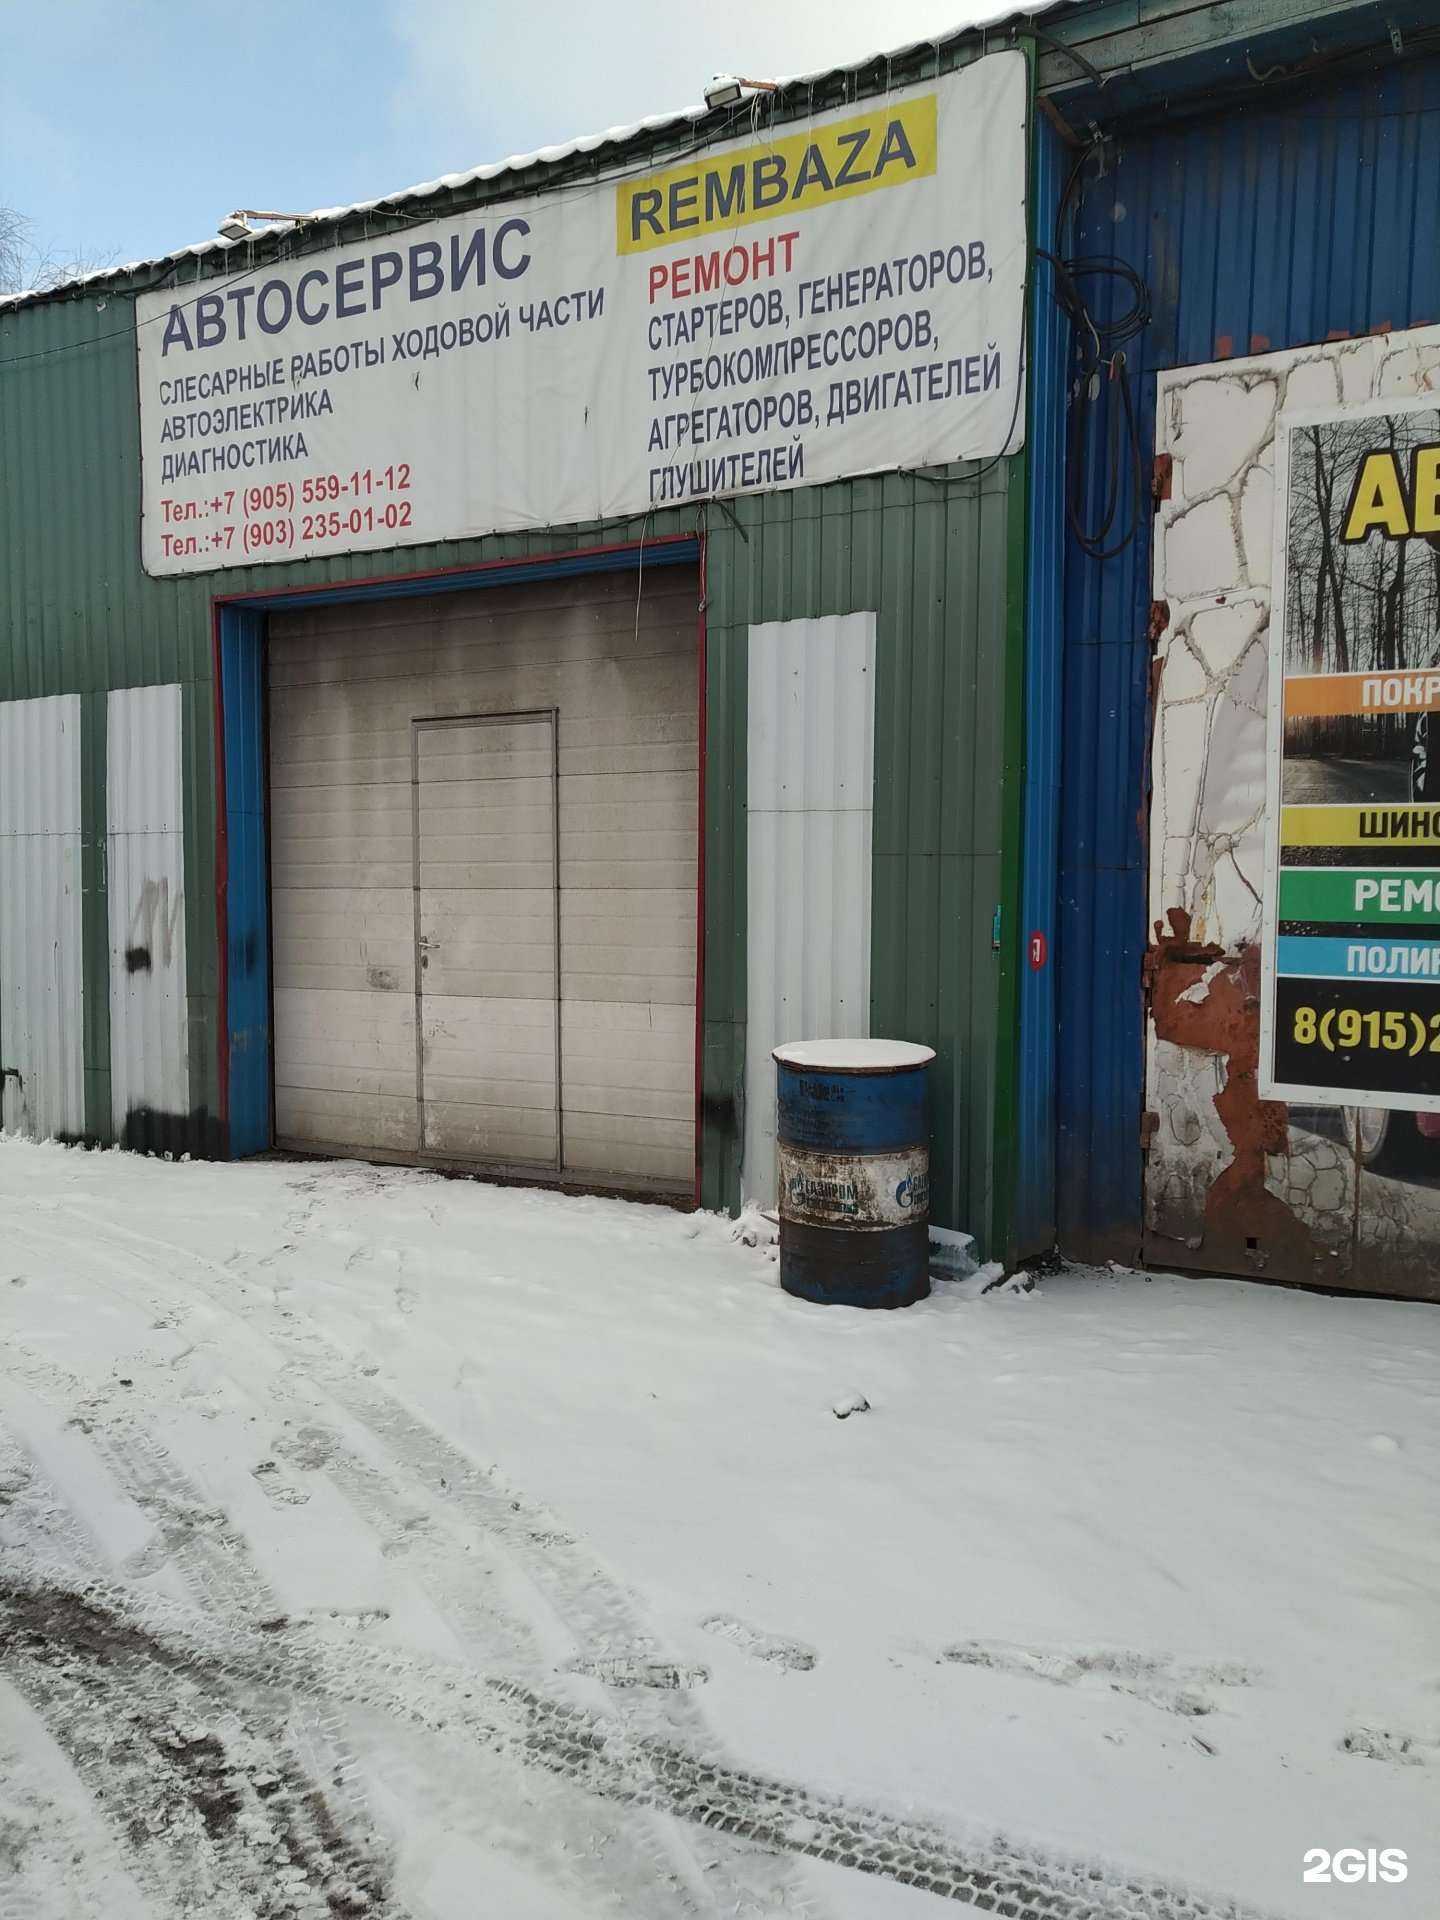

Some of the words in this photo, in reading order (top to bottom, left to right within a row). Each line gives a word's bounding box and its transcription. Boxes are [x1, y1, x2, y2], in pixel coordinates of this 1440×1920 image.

[632, 120, 916, 241] REMBAZA
[162, 218, 531, 357] АВТОСЕРВИС
[648, 289, 790, 350] СТАРТЕРОВ,
[799, 241, 992, 319] ГЕНЕРАТОРОВ,
[649, 231, 800, 304] РЕМОНТ
[160, 358, 285, 405] СЛЕСАРНЫЕ
[291, 337, 385, 382] РАБОТЫ
[392, 302, 510, 361] ХОДОВОЙ
[519, 287, 604, 332] ЧАСТИ
[647, 310, 939, 400] ТУРБОКОМПРЕССОРОВ,
[160, 389, 333, 443] АВТОЭЛЕКТРИКА
[648, 389, 820, 452] АГРЕГАТОРОВ,
[827, 341, 1000, 427] ДВИГАТЕЛЕЙ
[161, 432, 308, 485] ДИАГНОСТИКА
[243, 482, 295, 519] (905)
[302, 464, 410, 503] 559-11-12
[650, 434, 804, 501] ГЛУШИТЕЛЕЙ
[243, 518, 295, 554] (903)
[302, 501, 412, 540] 235-01-02
[1362, 676, 1440, 707] ПОКР
[1355, 879, 1440, 912] РЕМ
